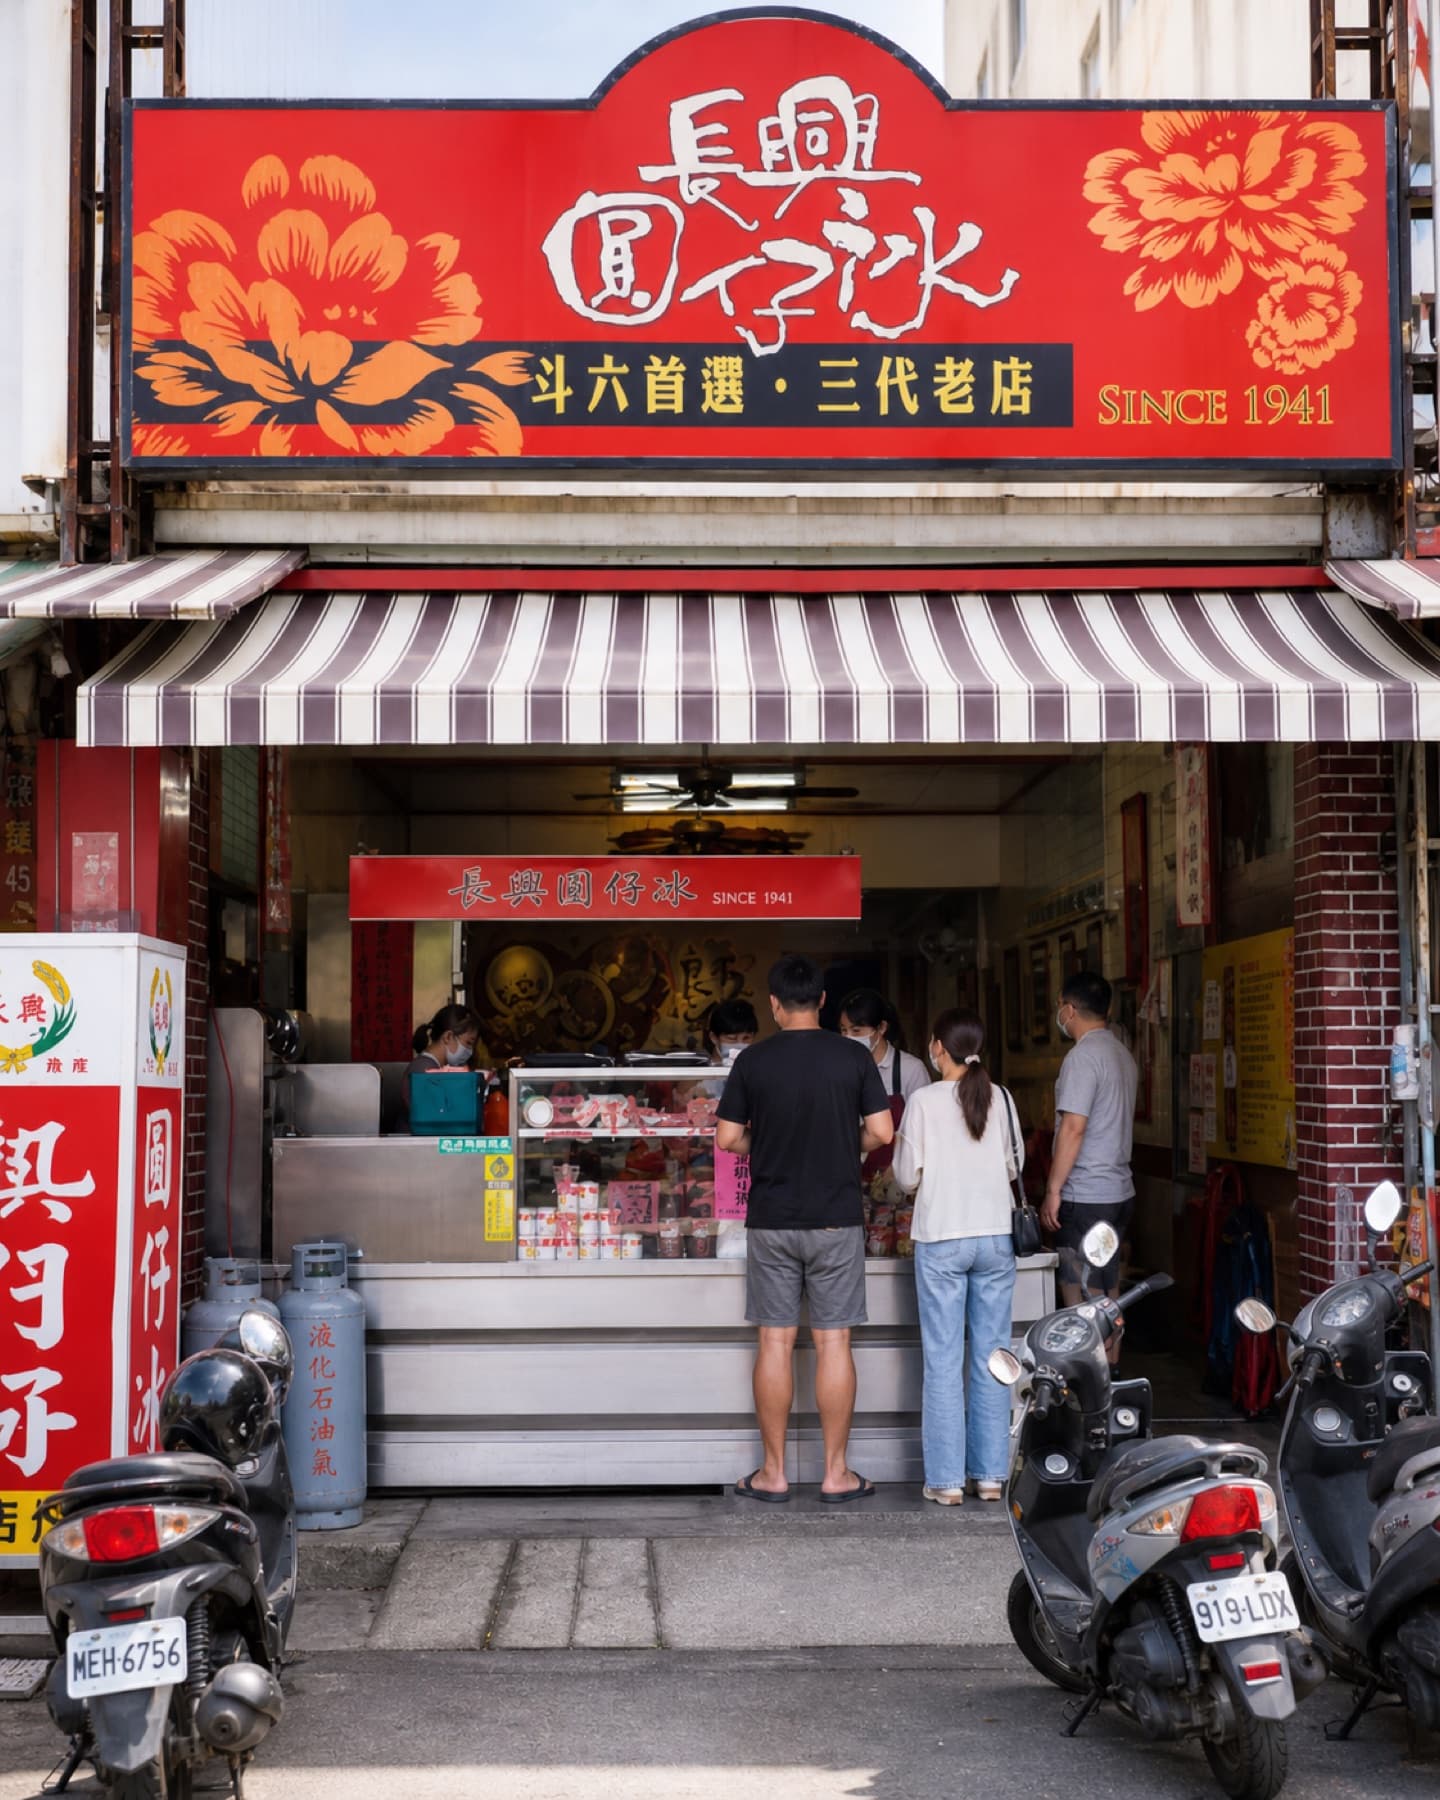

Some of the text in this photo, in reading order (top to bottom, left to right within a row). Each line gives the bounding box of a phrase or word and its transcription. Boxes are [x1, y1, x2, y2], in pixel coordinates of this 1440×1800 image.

[638, 75, 922, 232] 長興
[541, 186, 1021, 357] 圓仔冰
[1098, 384, 1334, 425] SINCE 1941
[447, 866, 699, 909] 長興圓仔冰
[712, 891, 793, 905] SINCE 1941
[308, 1323, 337, 1478] 液化石油氣
[1195, 1589, 1294, 1629] 919-LDX
[72, 1637, 181, 1682] MEH-6756
